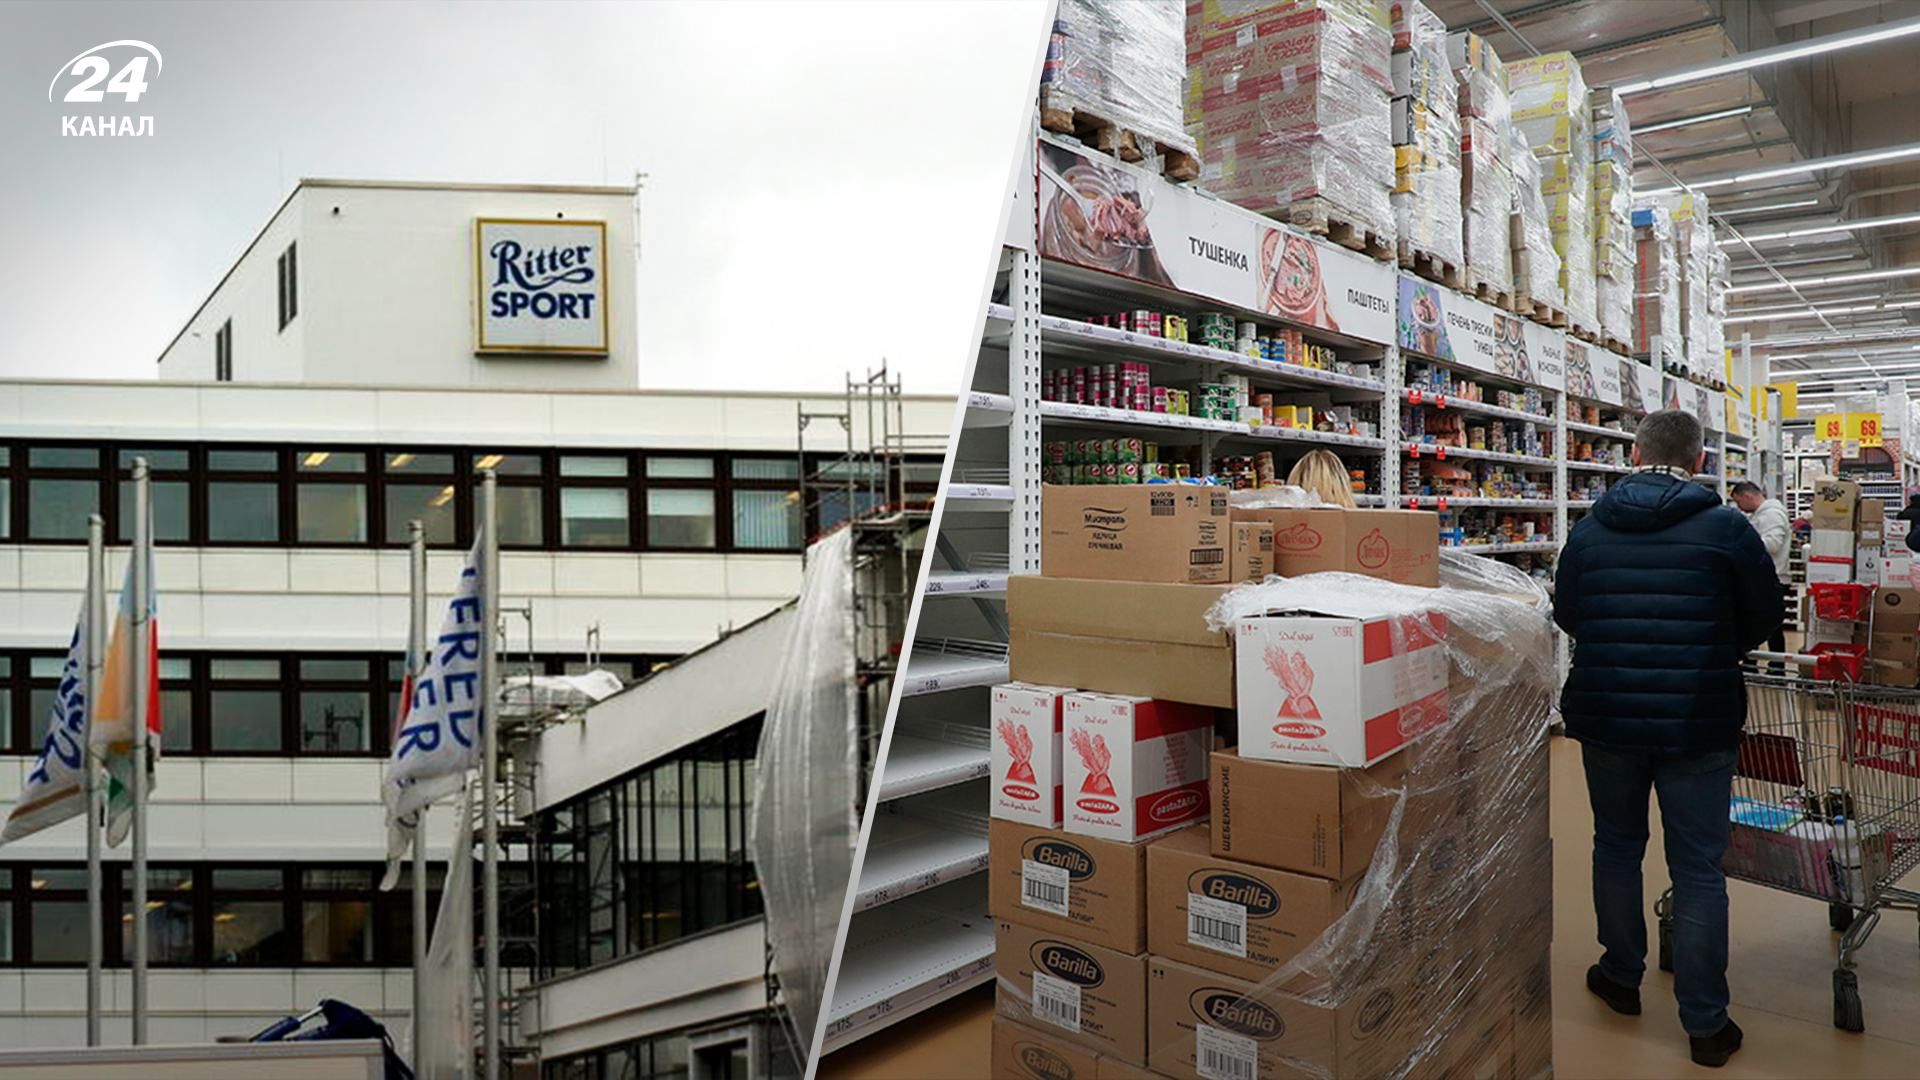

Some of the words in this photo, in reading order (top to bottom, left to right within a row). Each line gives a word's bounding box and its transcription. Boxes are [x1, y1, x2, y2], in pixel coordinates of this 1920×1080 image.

[490, 240, 594, 290] Ritter
[1188, 236, 1249, 272] ТУШЕНКА
[491, 291, 595, 319] SPORT
[1347, 288, 1390, 314] ПАШТЕТЫ
[1861, 419, 1876, 436] 69
[1156, 795, 1197, 817] pastaZARA
[1222, 765, 1231, 852] ШЕБЕКИНСКИЕ
[1039, 846, 1090, 873] Barilla
[1209, 879, 1272, 908] Barilla
[1047, 950, 1097, 980] Barilla
[1211, 999, 1275, 1032] Barilla
[1026, 1049, 1069, 1080] Barilla
